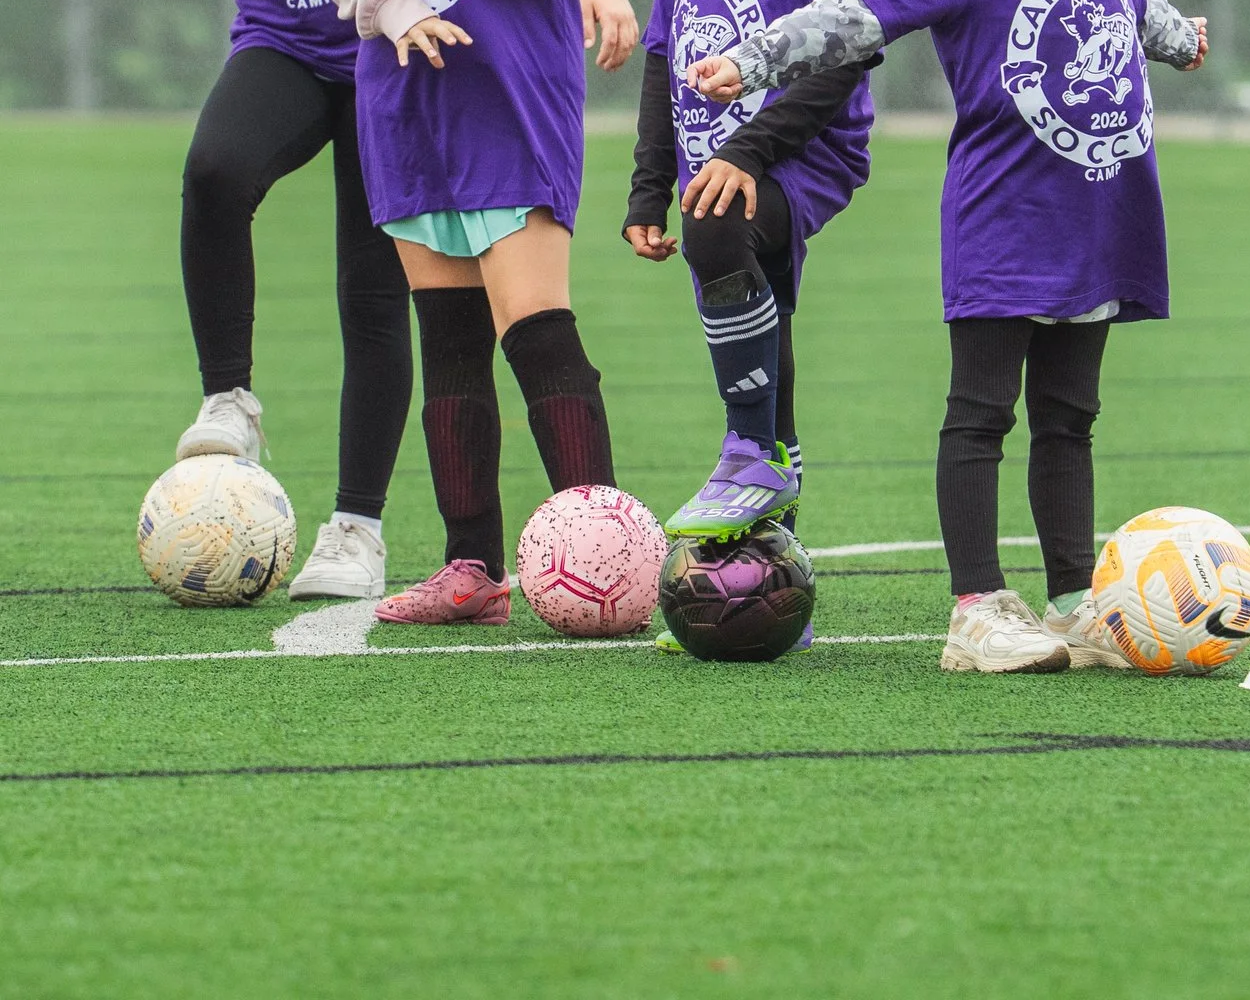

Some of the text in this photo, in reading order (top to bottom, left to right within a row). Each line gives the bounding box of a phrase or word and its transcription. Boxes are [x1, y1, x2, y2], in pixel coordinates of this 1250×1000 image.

[683, 107, 709, 126] 202
[1090, 110, 1128, 130] 2026
[1084, 163, 1122, 182] CAMP
